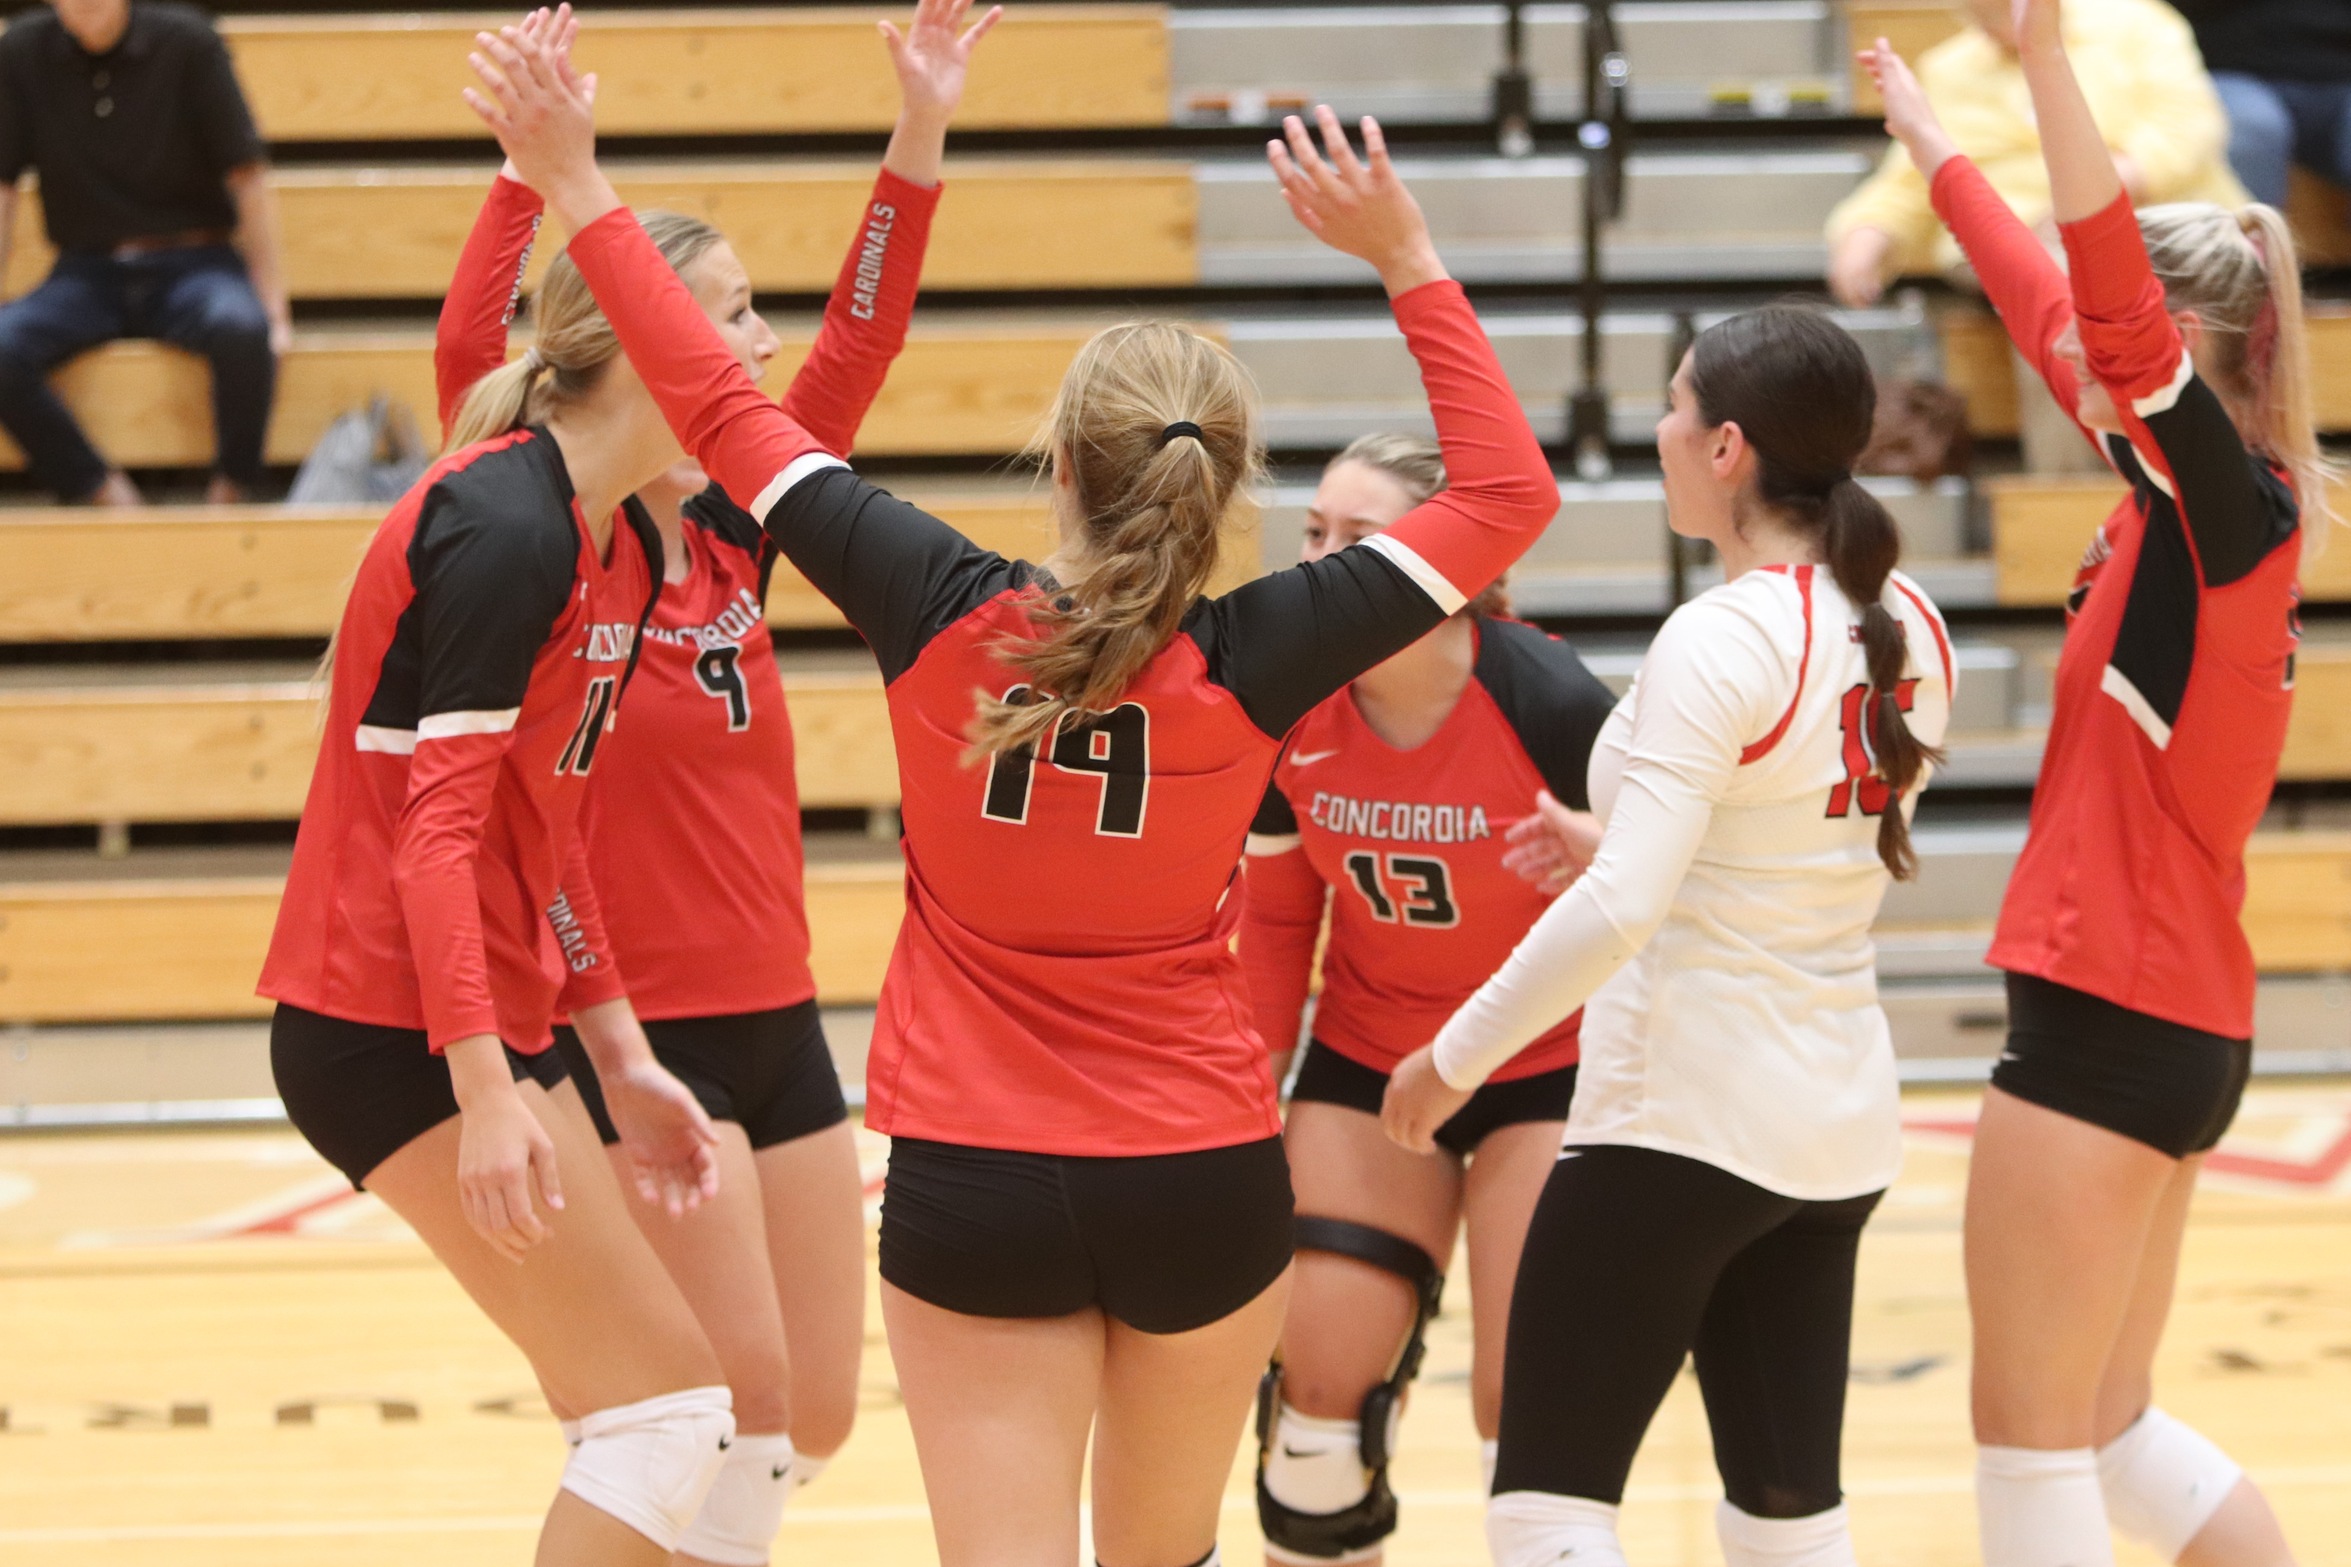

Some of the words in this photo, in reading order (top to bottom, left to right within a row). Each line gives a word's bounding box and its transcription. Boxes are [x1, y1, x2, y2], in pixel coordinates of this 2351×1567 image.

[850, 202, 896, 321] CARDINALS
[693, 642, 751, 733] 9
[981, 683, 1151, 839] 19
[1309, 791, 1491, 843] CONCORDIA
[1343, 850, 1460, 929] 13
